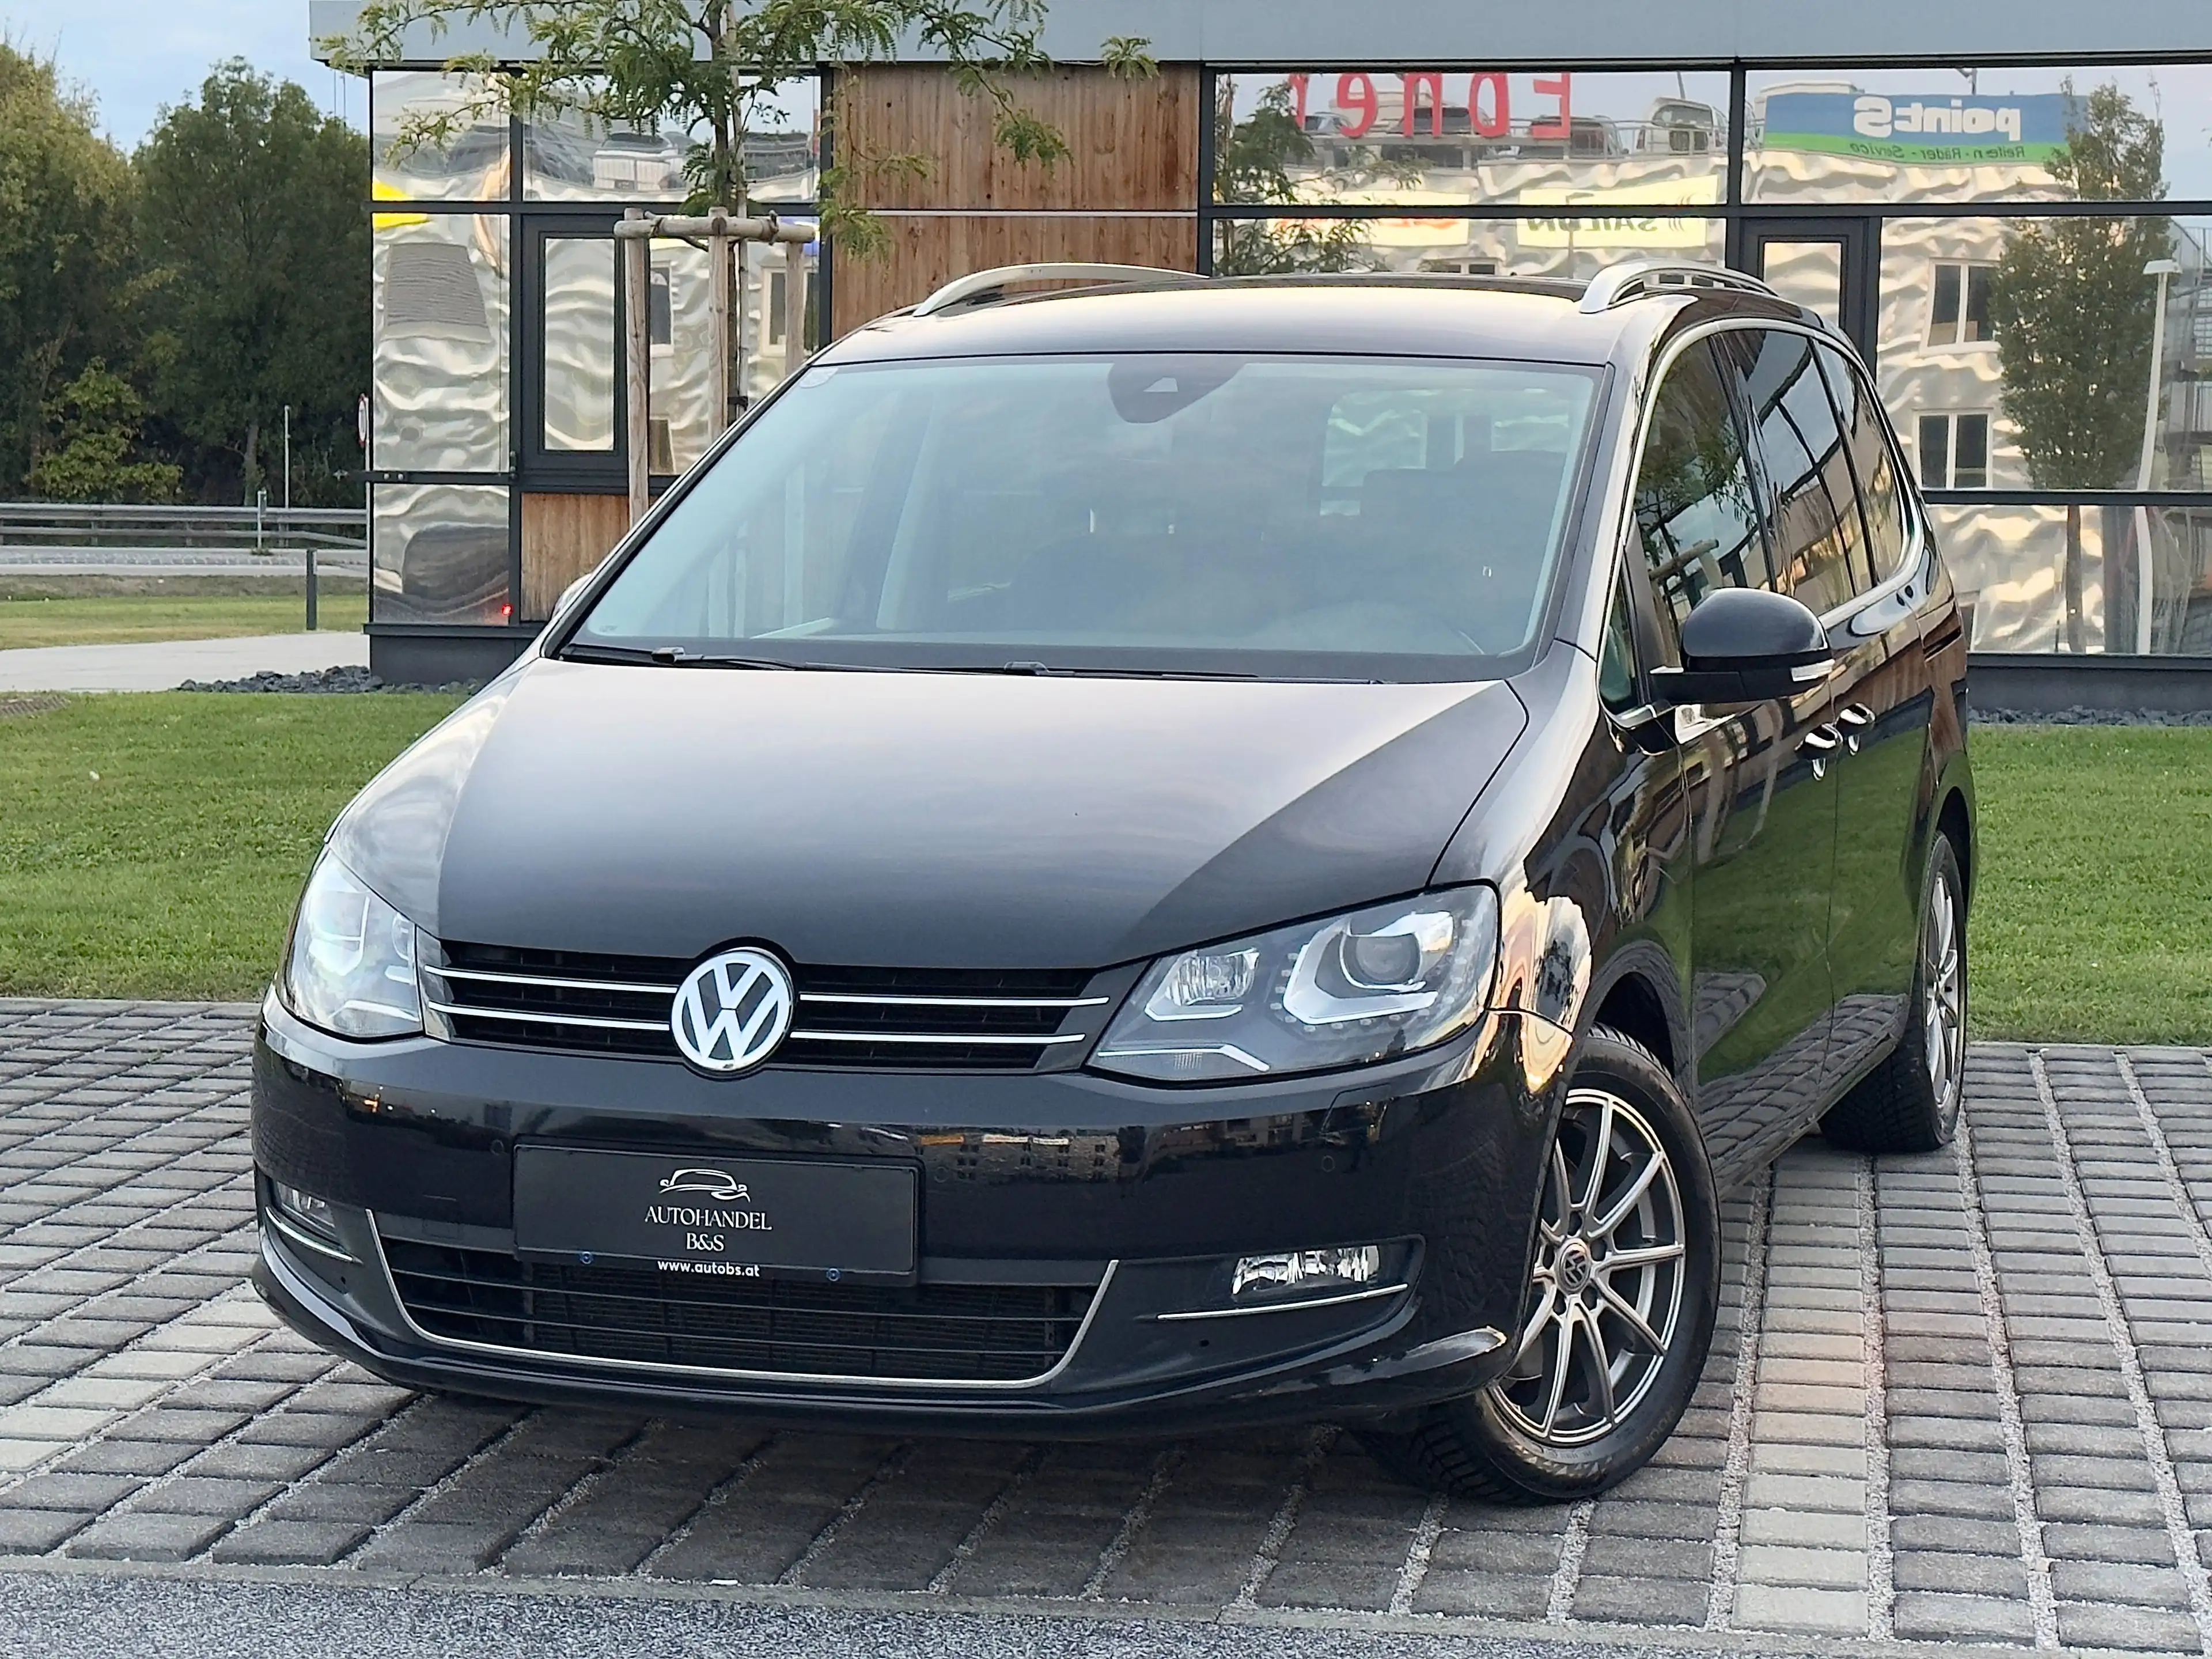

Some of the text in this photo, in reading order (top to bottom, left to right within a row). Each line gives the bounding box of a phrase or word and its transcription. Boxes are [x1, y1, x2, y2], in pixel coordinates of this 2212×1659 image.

[645, 1206, 772, 1230] AUTOHANDEL
[686, 1233, 724, 1251] B&S
[657, 1260, 760, 1277] www.autobs.at
